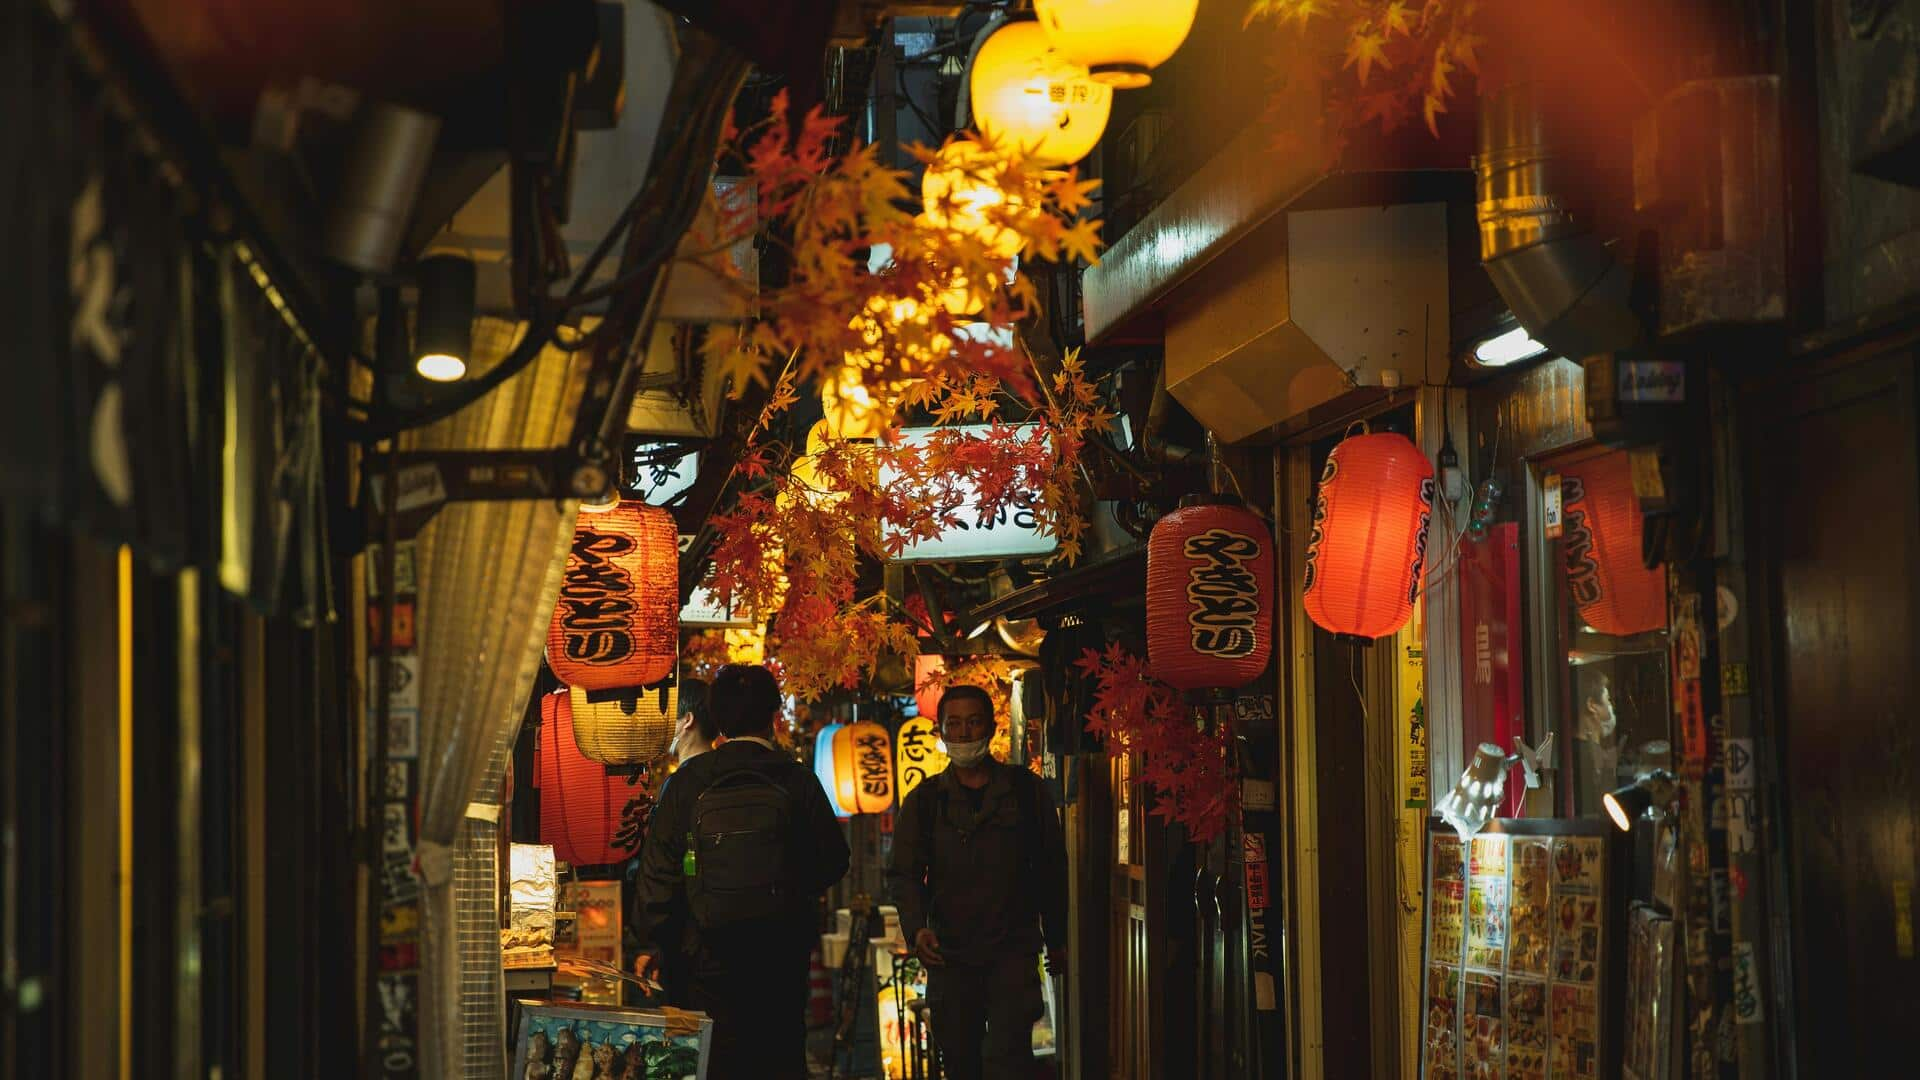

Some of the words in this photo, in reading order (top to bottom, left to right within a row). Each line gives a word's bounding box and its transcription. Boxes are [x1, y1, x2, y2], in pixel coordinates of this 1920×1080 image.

[562, 531, 636, 664] やきとり
[1183, 529, 1260, 658] やきとり
[857, 734, 889, 797] やきとり
